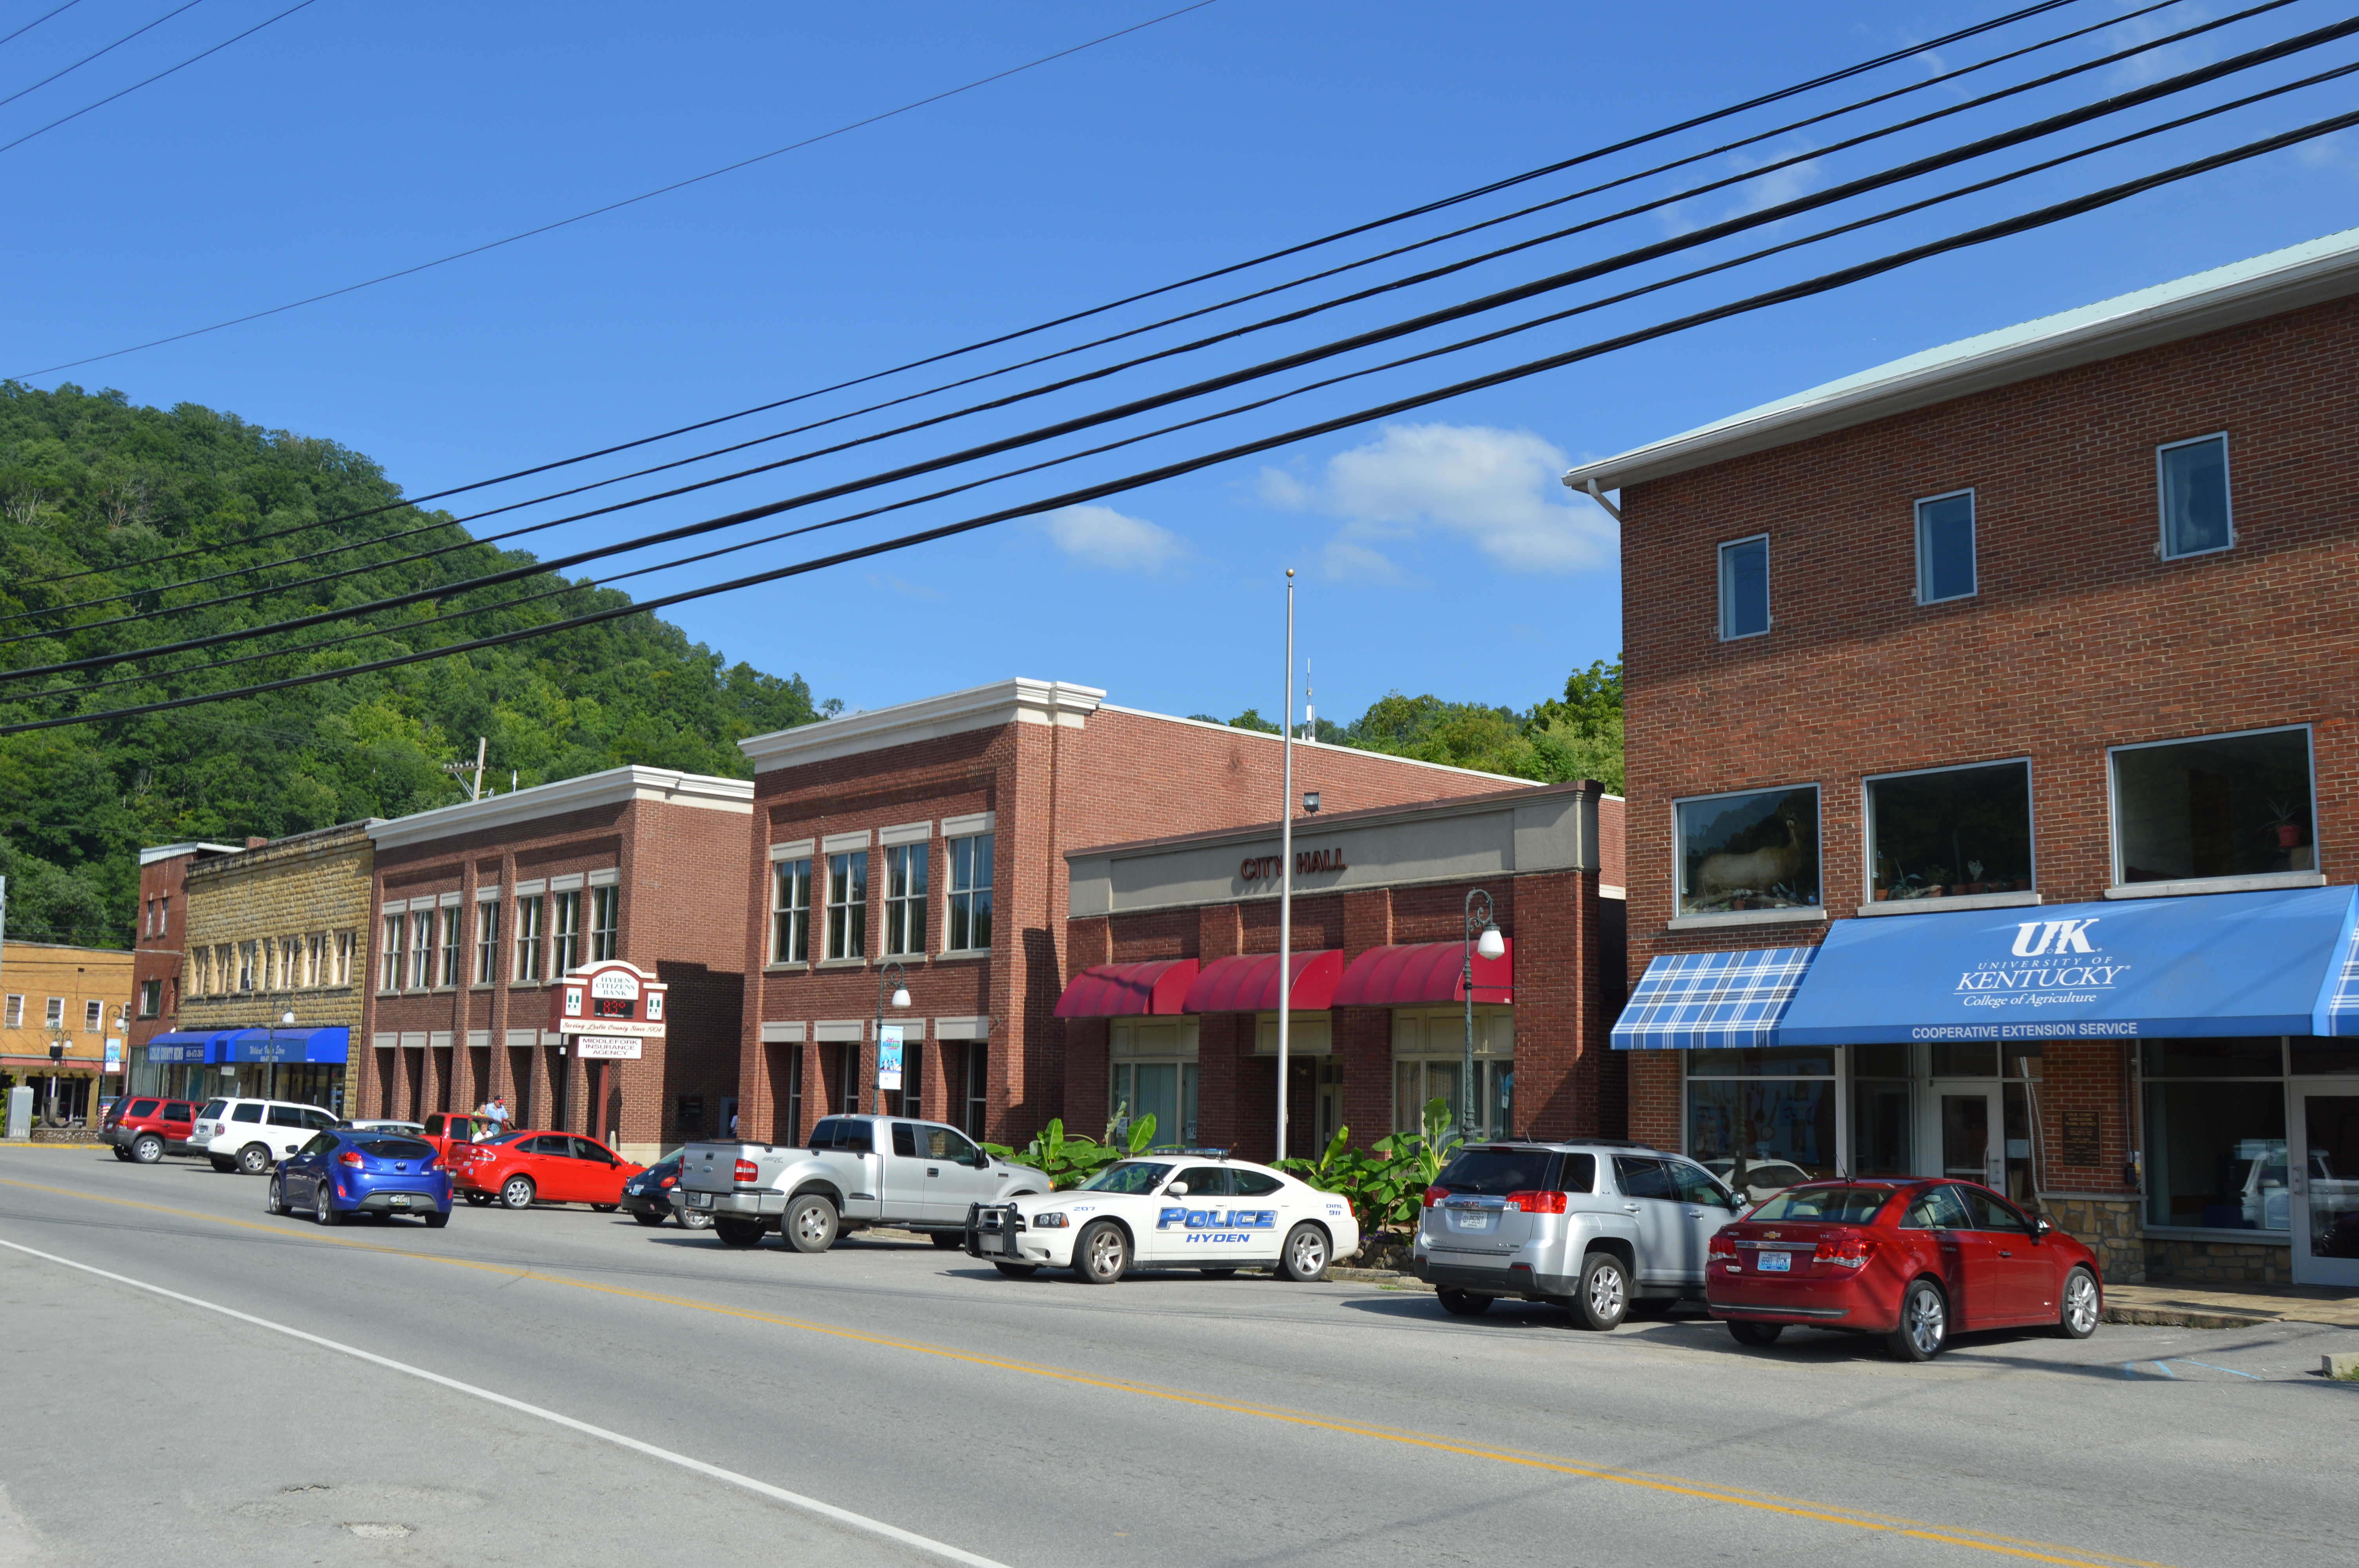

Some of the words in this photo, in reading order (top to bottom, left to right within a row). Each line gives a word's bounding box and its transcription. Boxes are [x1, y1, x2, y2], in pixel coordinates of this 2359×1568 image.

[1241, 855, 1283, 879] CITY
[1296, 848, 1348, 874] HALL
[2012, 918, 2099, 956] UK
[1978, 958, 2082, 969] UNIVERSITY
[1956, 965, 2125, 990] KENTUCKY
[1964, 995, 2008, 1008] College
[2010, 994, 2028, 1004] of
[2028, 992, 2097, 1007] Agriculture
[1912, 1026, 1999, 1038] COOPERATIVE
[2002, 1024, 2075, 1036] EXTENSION
[2079, 1022, 2137, 1035] SERVICE
[1156, 1207, 1278, 1230] POLICE
[1468, 1216, 1484, 1224] P5267
[1186, 1234, 1250, 1243] HYDEN
[1762, 1257, 1772, 1265] 890
